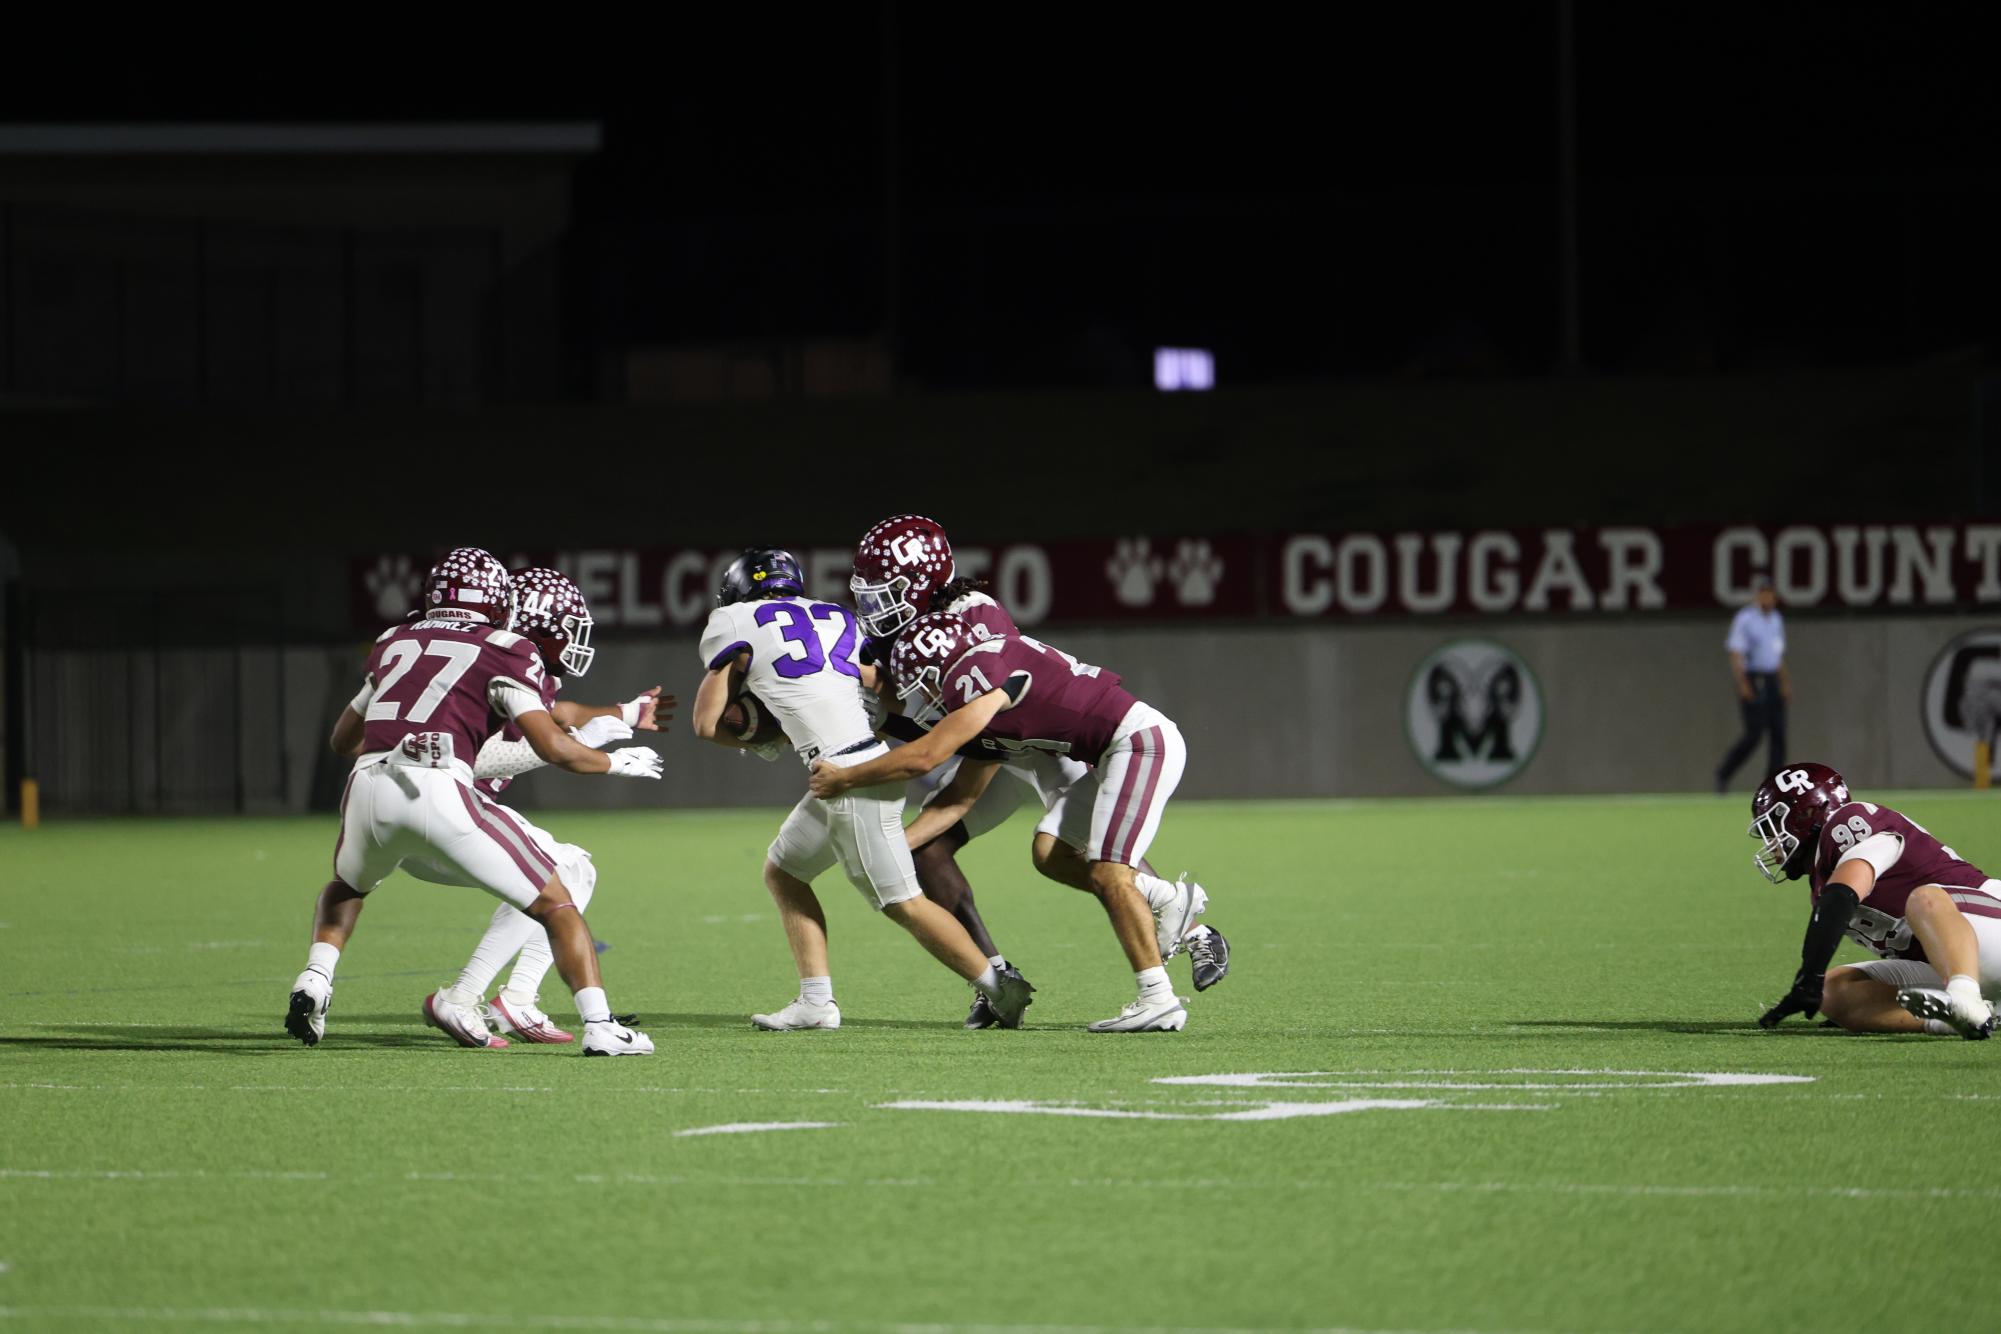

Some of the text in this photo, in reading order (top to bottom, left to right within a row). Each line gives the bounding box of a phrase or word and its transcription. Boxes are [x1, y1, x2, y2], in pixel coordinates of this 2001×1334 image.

[1282, 526, 1668, 616] COUGAR
[523, 591, 554, 619] 44
[753, 602, 862, 680] 32
[913, 628, 956, 658] CR
[365, 639, 482, 723] 27
[955, 665, 994, 704] 21
[1775, 769, 1815, 795] CR
[1831, 815, 1873, 853] 99
